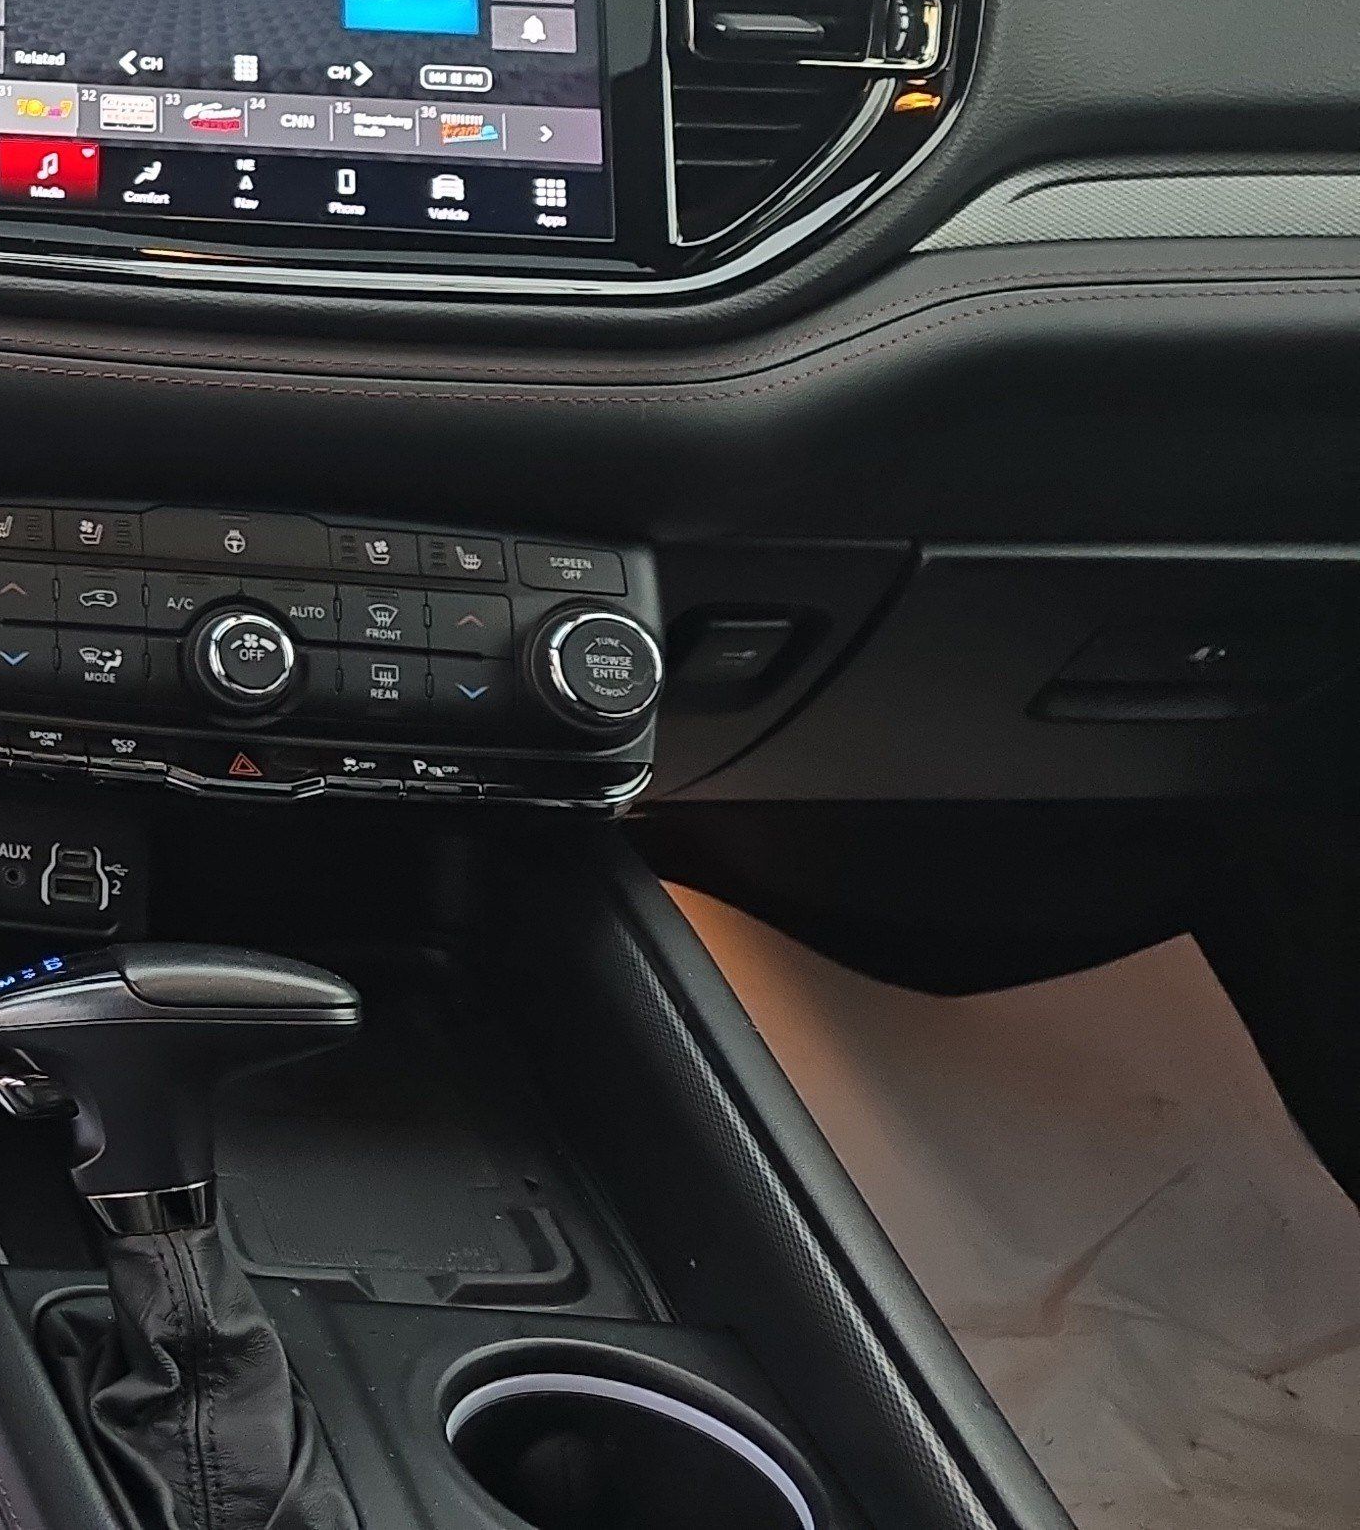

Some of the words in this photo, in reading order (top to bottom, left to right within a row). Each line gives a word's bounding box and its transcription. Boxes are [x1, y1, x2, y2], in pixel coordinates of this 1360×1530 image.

[15, 50, 65, 66] Related
[140, 56, 163, 71] CH
[327, 64, 352, 80] CH
[81, 89, 96, 102] 32
[165, 93, 180, 106] 33
[250, 97, 266, 110] 34
[335, 101, 351, 114] 35
[280, 114, 315, 128] CNN
[30, 185, 66, 200] Media
[123, 189, 171, 206] Comfort
[234, 197, 259, 210] Nav
[327, 201, 366, 216] Phone
[428, 207, 470, 221] Vehicle
[536, 213, 568, 228] Apps
[549, 556, 593, 570] SCREEN
[562, 569, 582, 581] OFF
[167, 597, 194, 611] A/C
[289, 605, 326, 620] AUTO
[366, 627, 402, 642] FRONT
[594, 636, 622, 649] TUNE
[239, 648, 266, 662] OFF
[585, 653, 633, 666] BROWSE
[84, 671, 117, 684] MODE
[592, 668, 630, 681] ENTER
[370, 688, 400, 701] REAR
[593, 684, 631, 698] SCROLL
[29, 729, 64, 742] SPORT
[39, 739, 56, 748] ON
[359, 761, 378, 770] OFF
[111, 879, 122, 895] 2
